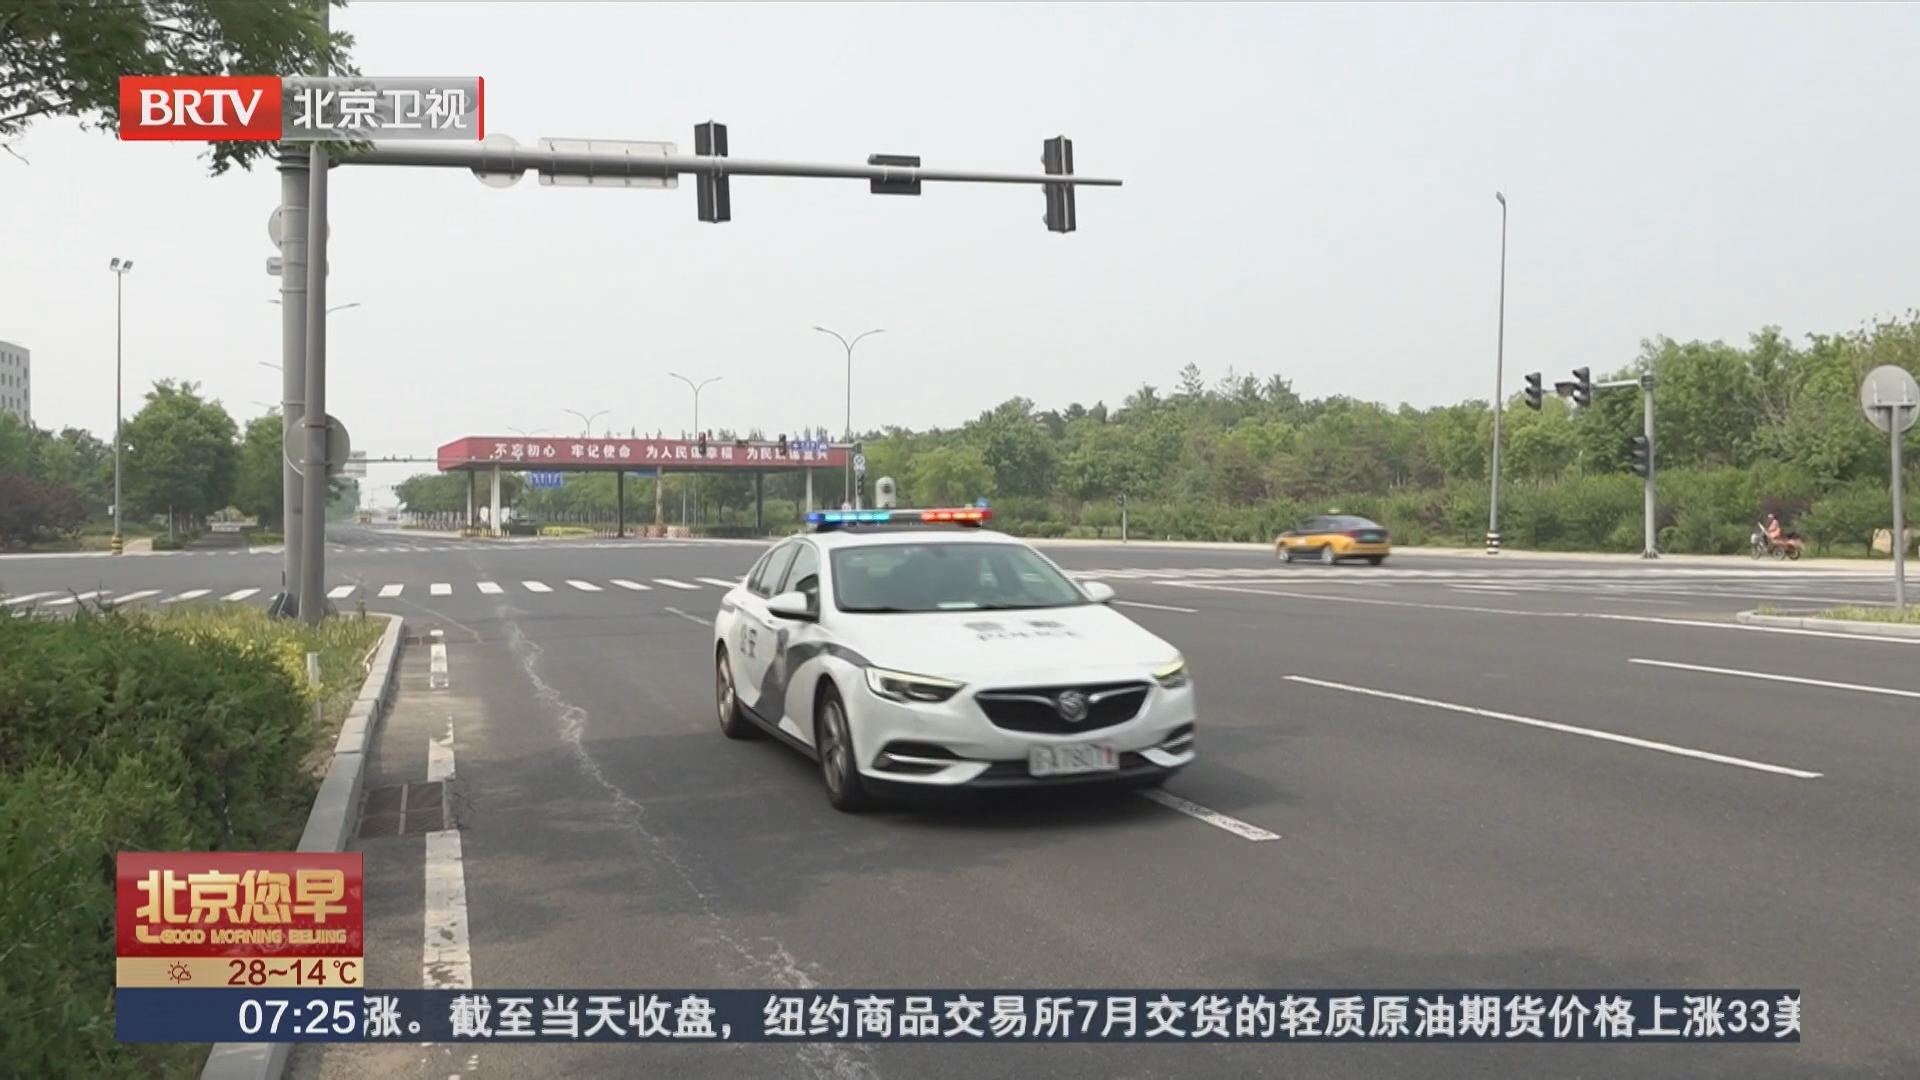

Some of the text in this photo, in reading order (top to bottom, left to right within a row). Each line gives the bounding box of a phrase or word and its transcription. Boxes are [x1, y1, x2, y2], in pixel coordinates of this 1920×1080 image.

[494, 443, 556, 459] 不忘初心
[571, 444, 631, 459] 牢记使命
